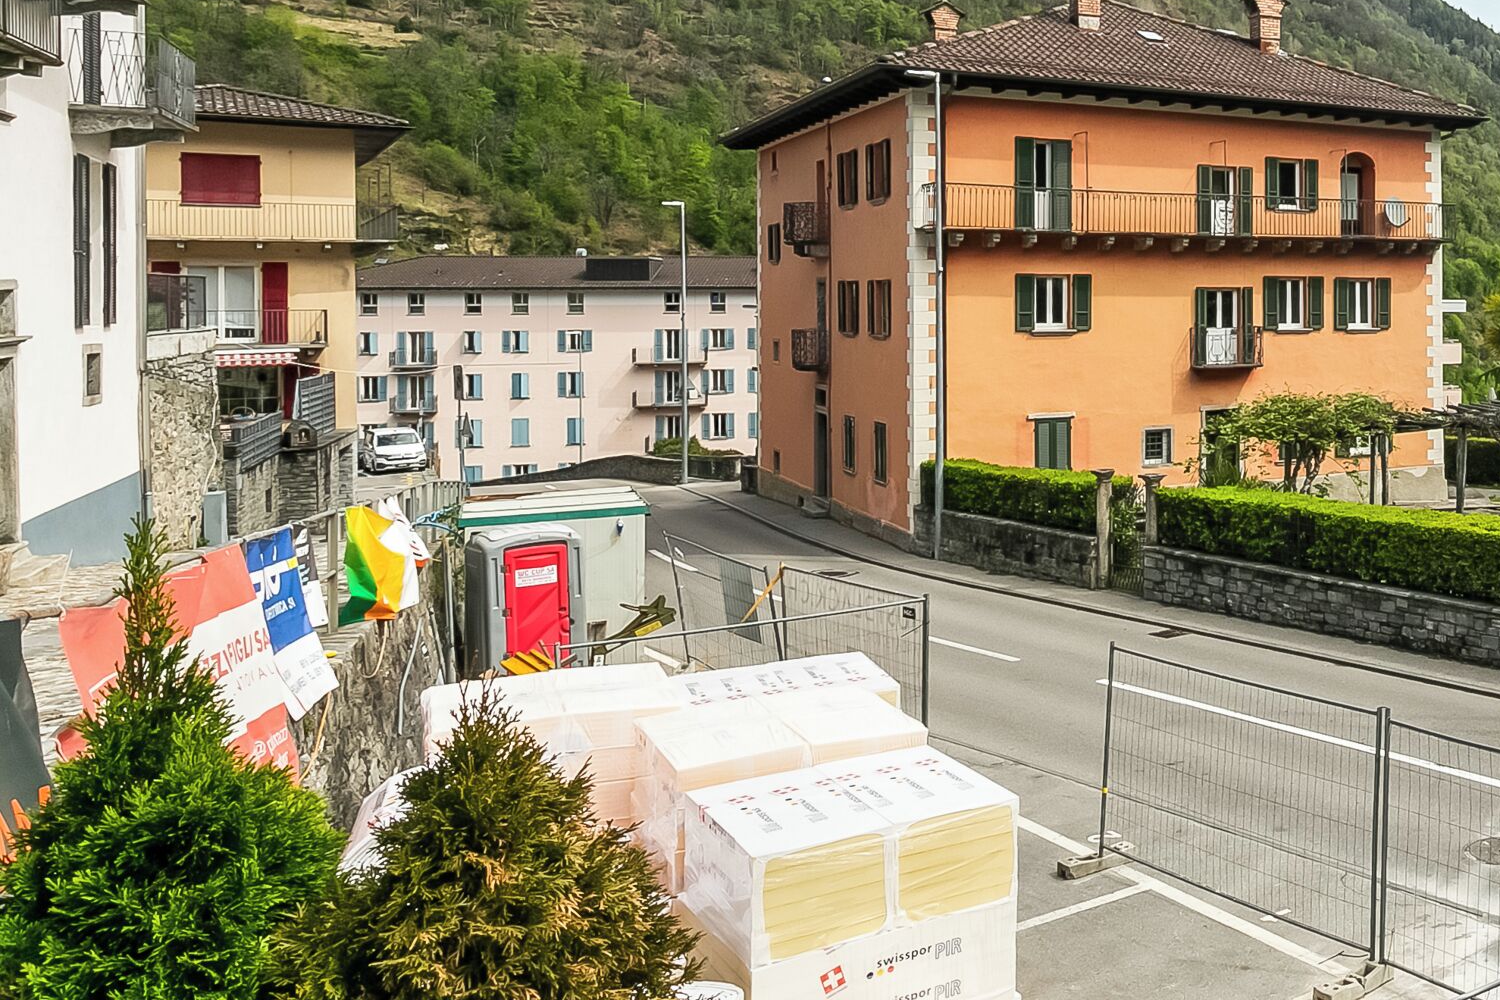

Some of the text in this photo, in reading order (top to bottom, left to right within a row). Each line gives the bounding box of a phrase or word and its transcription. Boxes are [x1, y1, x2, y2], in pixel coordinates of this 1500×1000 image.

[227, 634, 253, 665] FIGLI
[877, 937, 963, 968] swisspor PIR
[934, 979, 962, 1000] PIR
